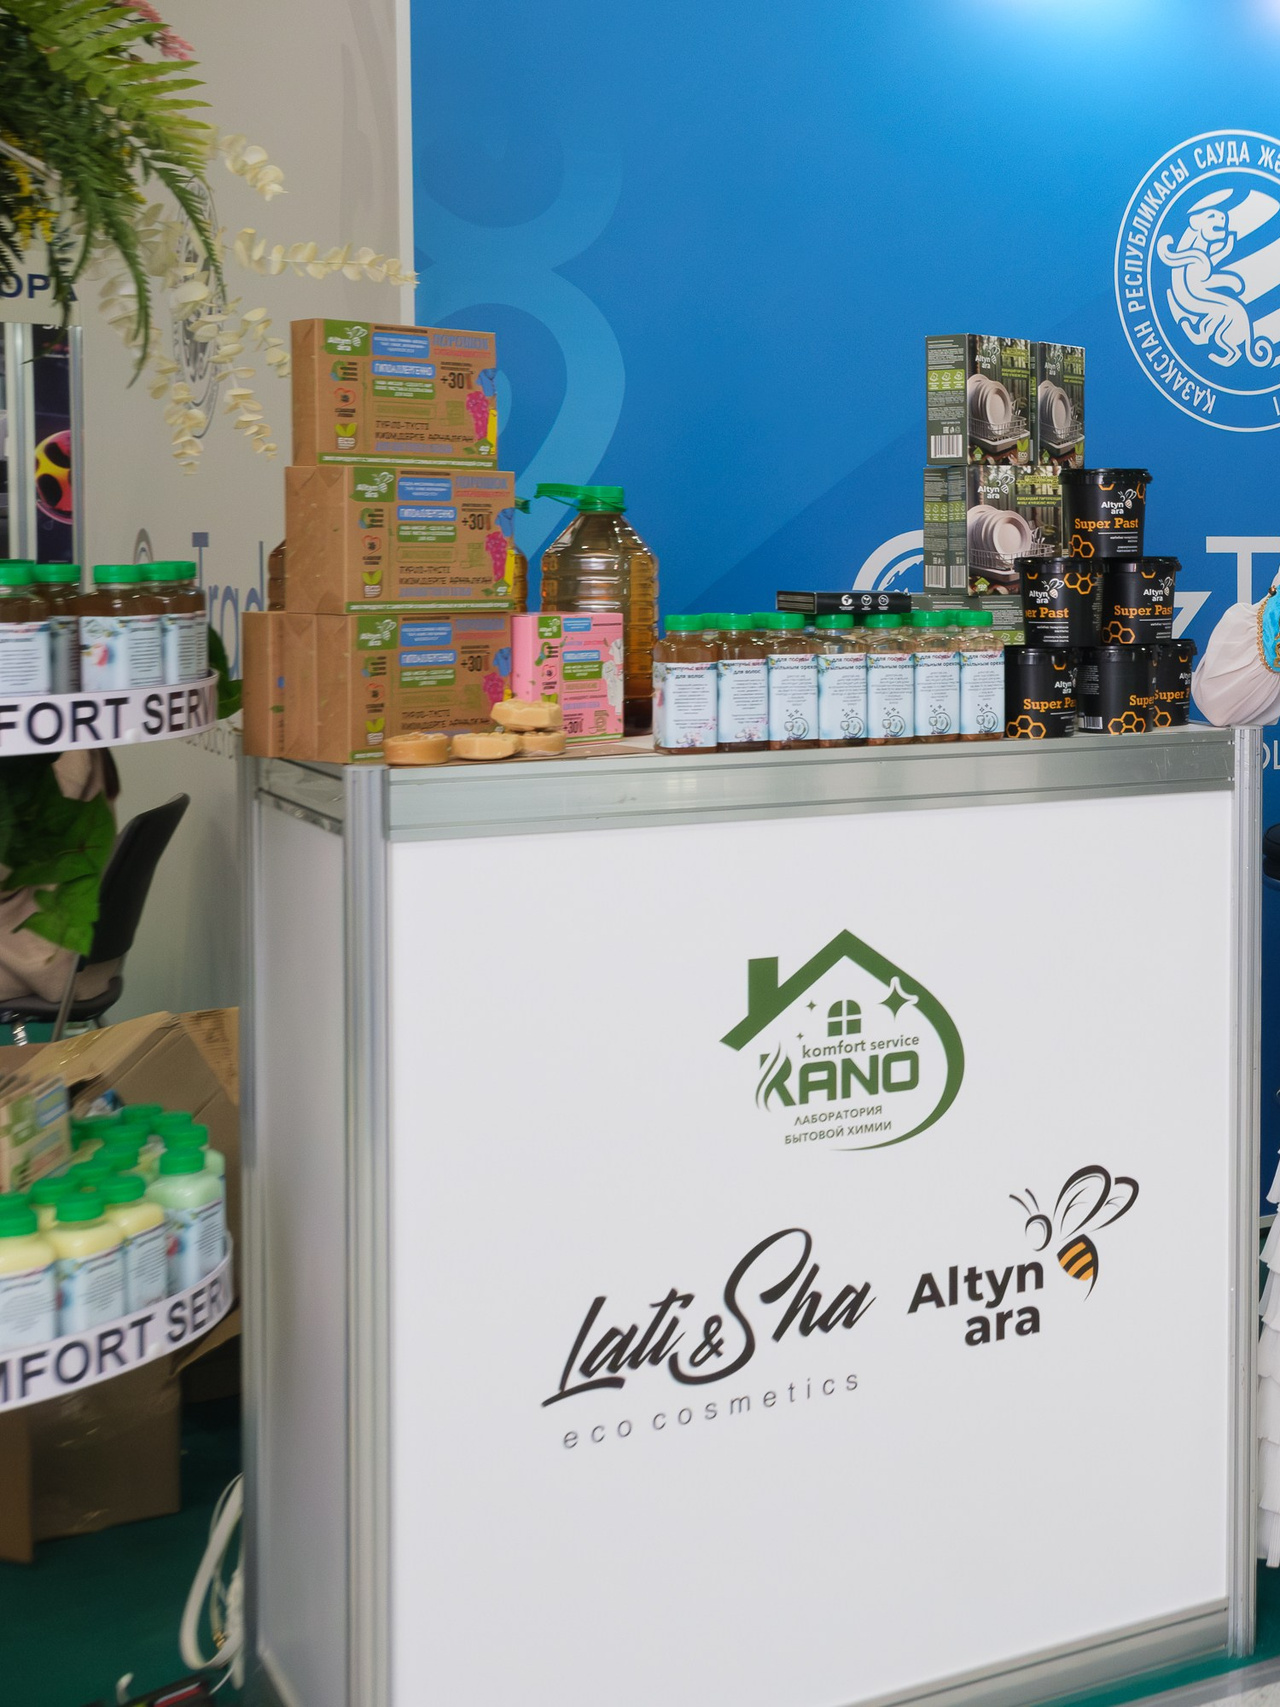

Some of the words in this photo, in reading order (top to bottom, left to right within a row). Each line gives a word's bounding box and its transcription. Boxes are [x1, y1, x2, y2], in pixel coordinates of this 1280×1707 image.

[1193, 141, 1250, 170] САУДА
[1124, 158, 1190, 313] РЕСПУБЛИКАСЫ
[1134, 320, 1216, 415] ҚАЗАҚСТАН
[977, 486, 1000, 495] Altyn
[1101, 501, 1124, 509] Altyn
[1074, 518, 1111, 532] Super
[1029, 590, 1048, 600] Altyn
[1143, 588, 1164, 598] Altyn
[1039, 607, 1070, 619] Past
[1114, 605, 1152, 619] Super
[1023, 699, 1062, 712] Super
[802, 1040, 866, 1058] komfort
[870, 1035, 920, 1050] service
[756, 1041, 919, 1112] KANO
[794, 1105, 883, 1126] ЛАБОРАТОРИЯ
[784, 1126, 844, 1145] БЫТОВОЙ
[847, 1120, 892, 1136] ХИМИИ
[907, 1259, 1045, 1314] Altyn
[963, 1303, 1042, 1347] ara
[563, 1420, 632, 1449] eco
[652, 1373, 860, 1431] cosmetics
